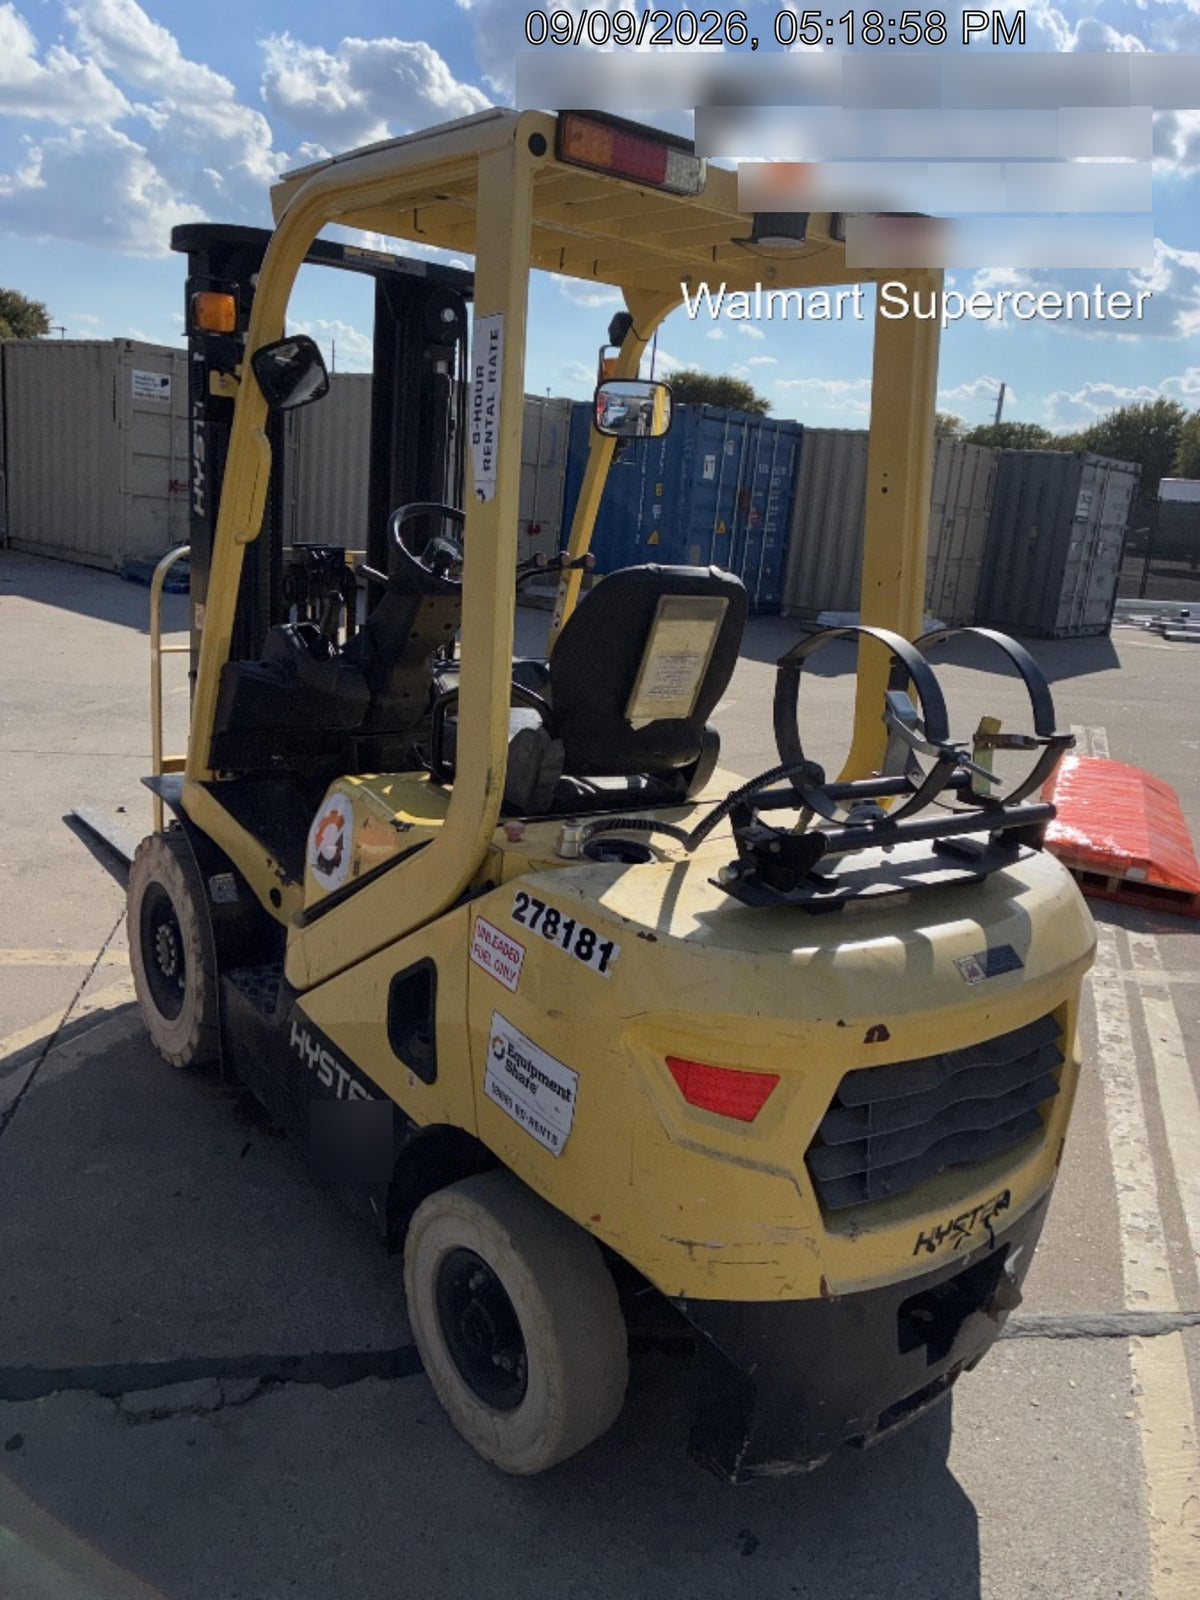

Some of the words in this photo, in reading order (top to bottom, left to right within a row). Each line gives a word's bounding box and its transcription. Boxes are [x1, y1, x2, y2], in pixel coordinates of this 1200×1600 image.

[488, 329, 499, 383] RATE
[483, 392, 497, 472] RENTAL
[477, 924, 520, 964] UNLEADED
[512, 892, 614, 973] 278181
[474, 944, 493, 968] FUEL
[494, 960, 516, 983] ONLY
[290, 1021, 375, 1100] HYSTE
[505, 1059, 538, 1095] Share
[507, 1042, 573, 1103] Equipment
